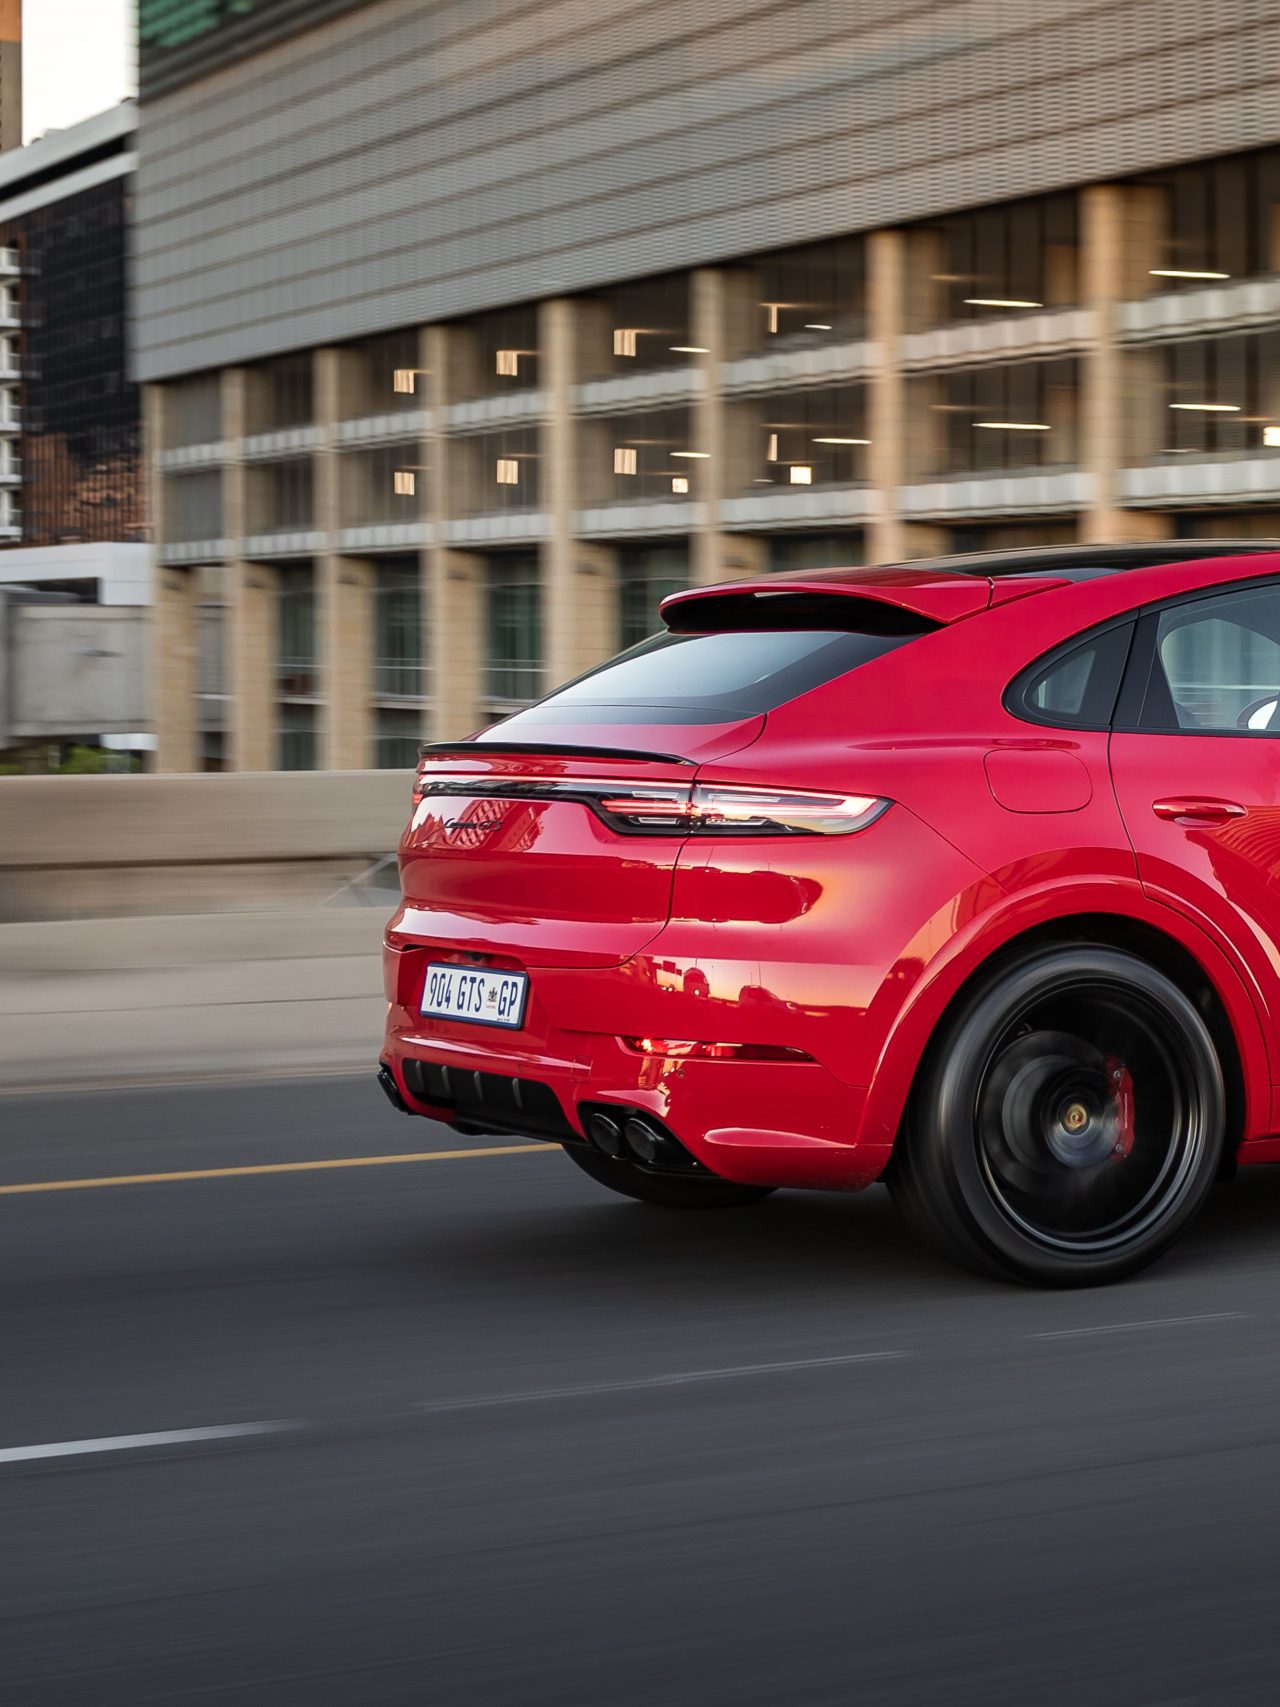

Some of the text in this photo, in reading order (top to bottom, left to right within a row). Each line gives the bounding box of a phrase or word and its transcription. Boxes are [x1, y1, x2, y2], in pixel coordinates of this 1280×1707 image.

[430, 972, 518, 1017] 904 GTS GP
